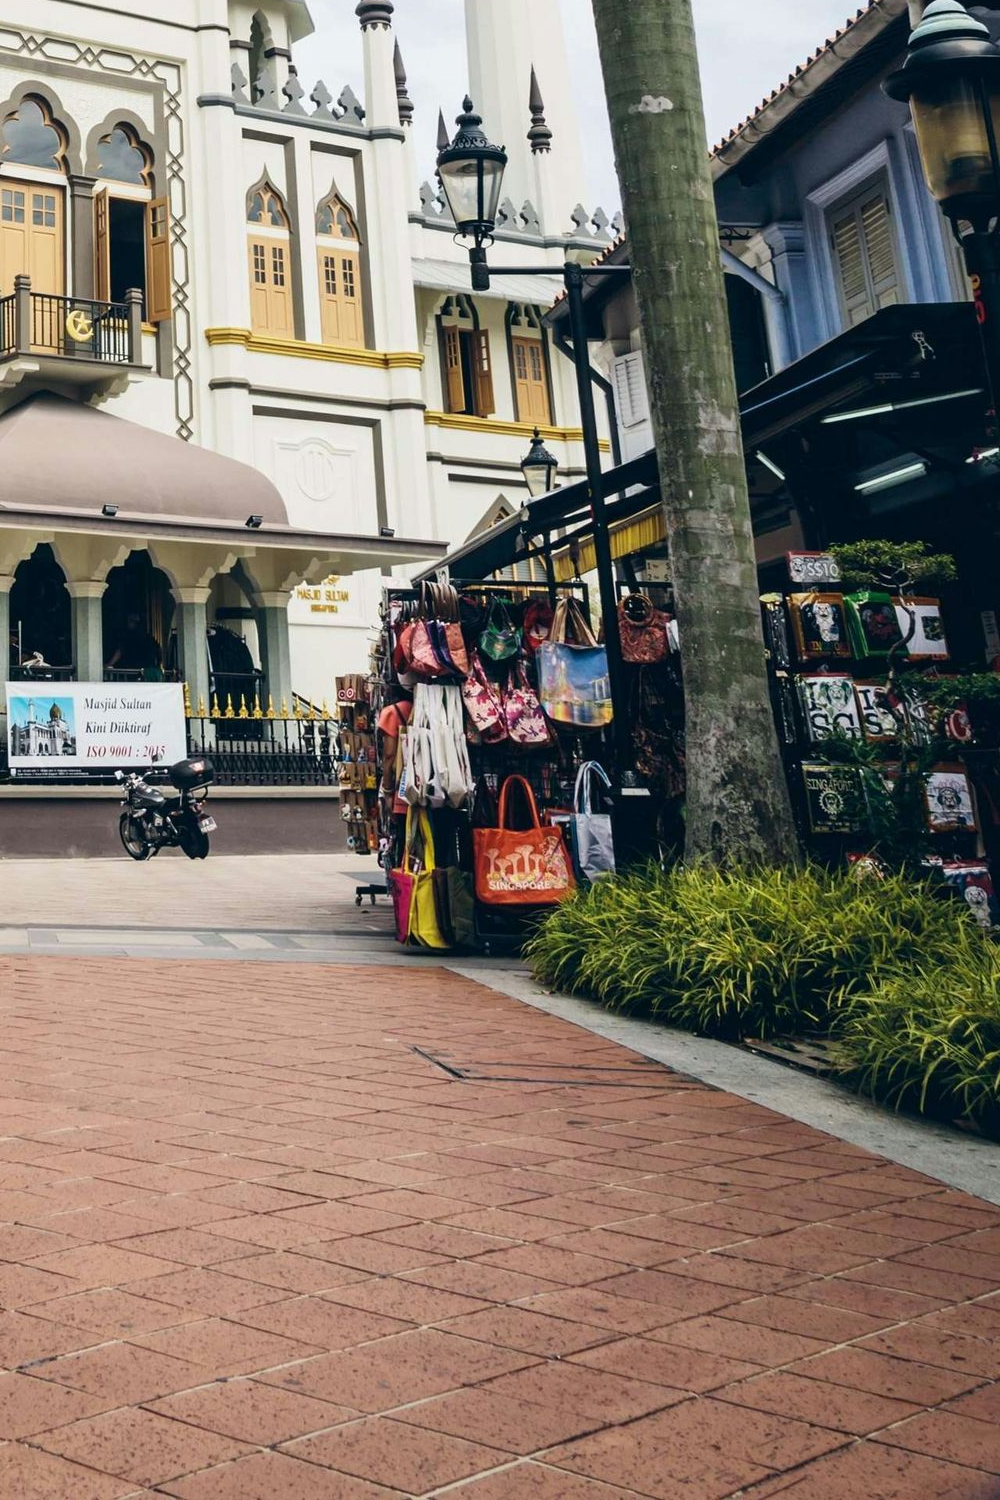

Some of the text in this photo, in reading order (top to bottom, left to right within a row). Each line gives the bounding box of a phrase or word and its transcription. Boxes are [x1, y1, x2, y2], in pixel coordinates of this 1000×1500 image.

[83, 697, 152, 713] Masjid Sultan
[85, 721, 107, 733] Kini
[86, 745, 107, 758] ISO
[109, 745, 132, 758] 9001
[143, 745, 166, 758] 2015
[488, 880, 552, 891] SINGAPORE
